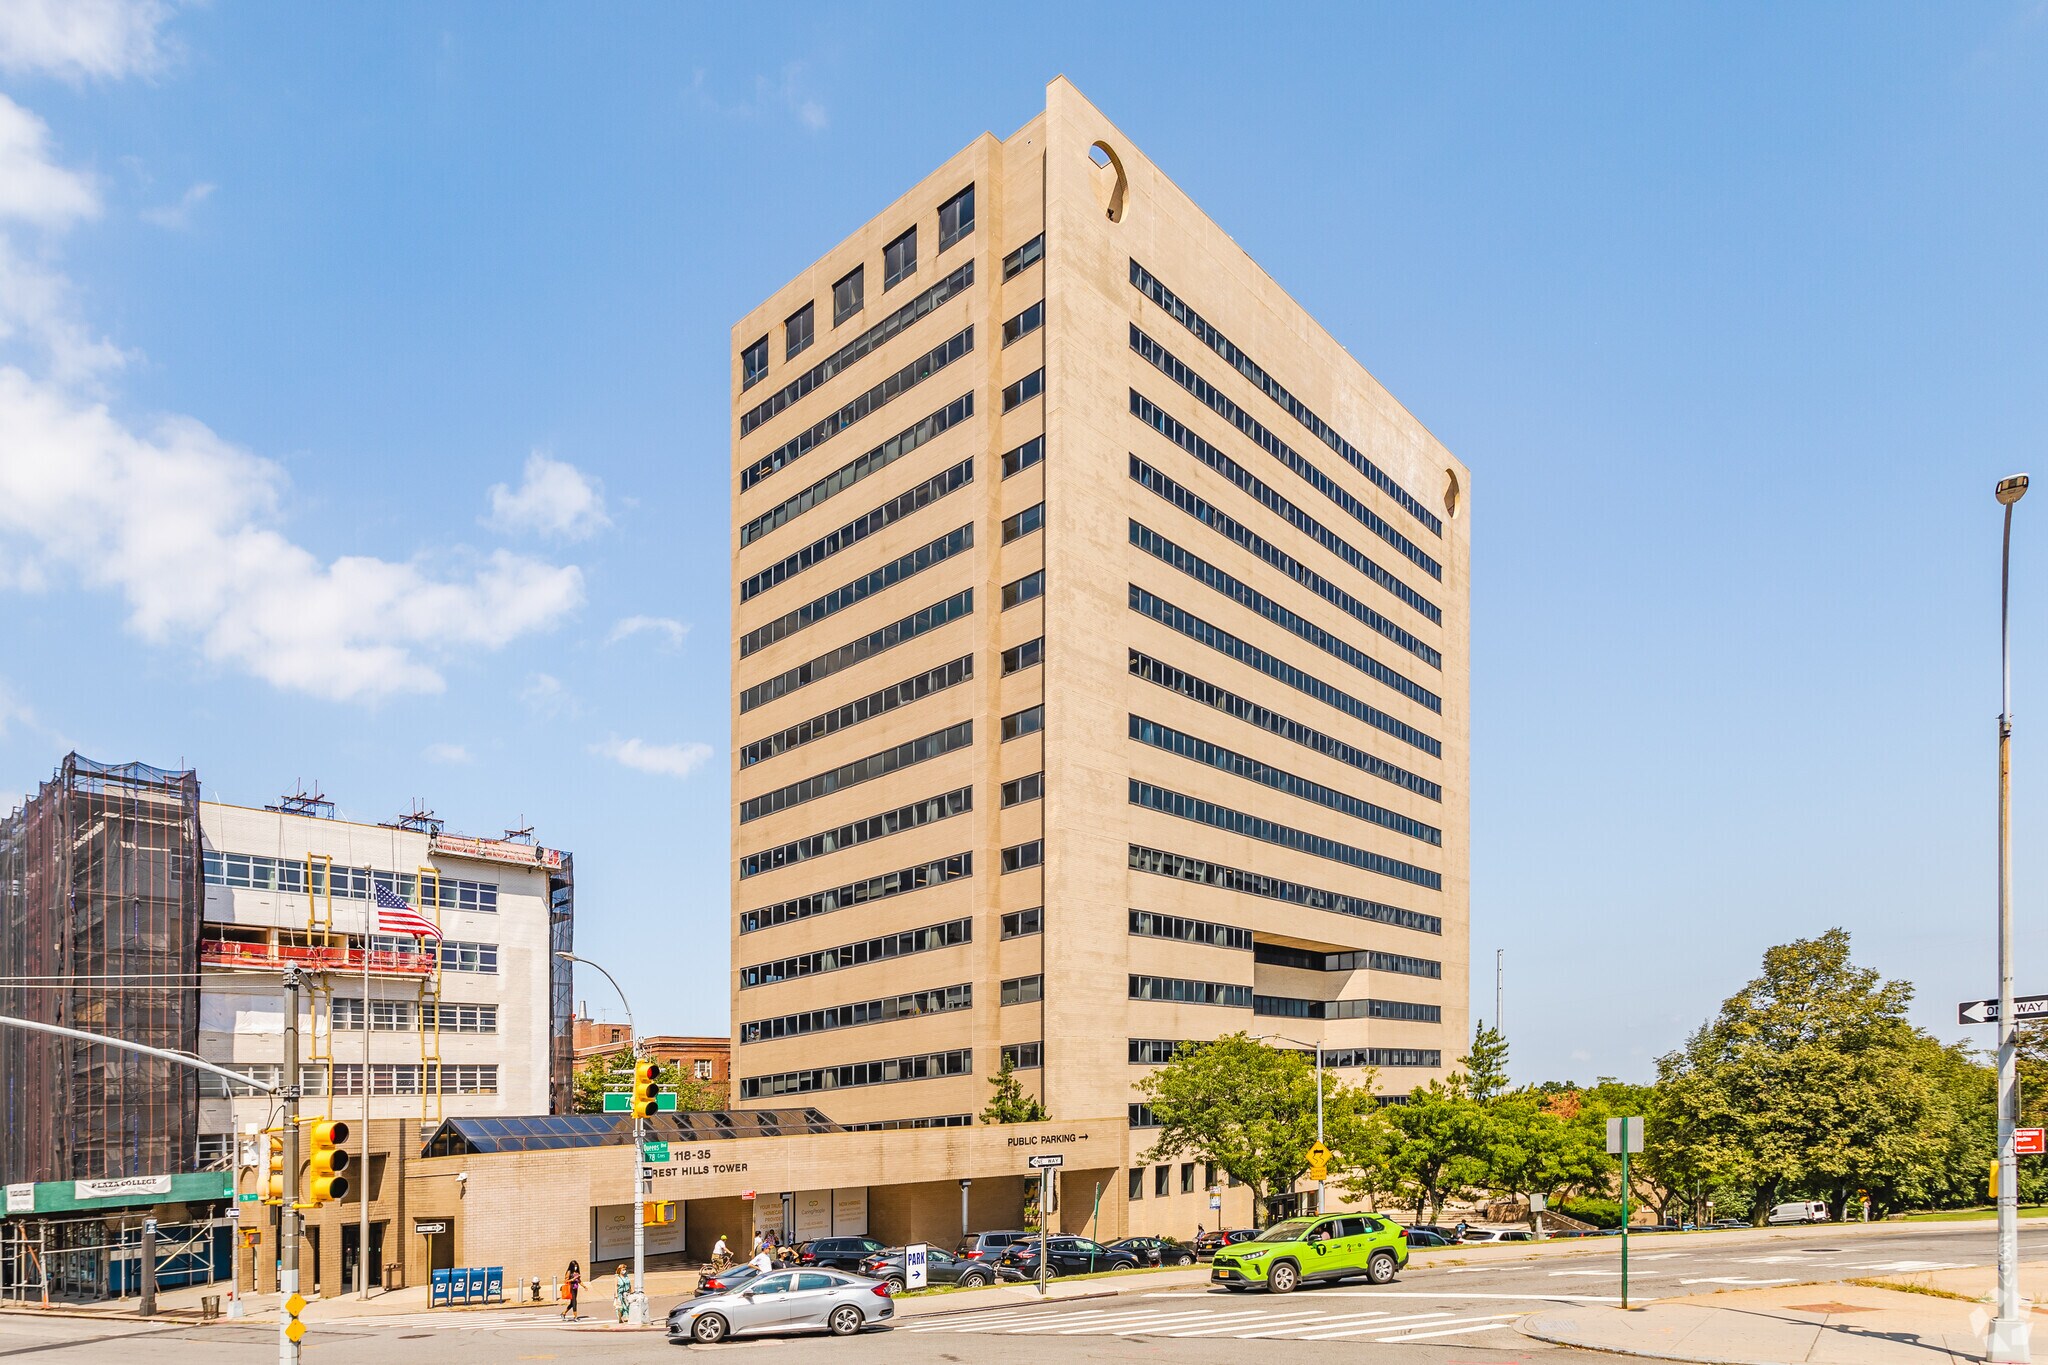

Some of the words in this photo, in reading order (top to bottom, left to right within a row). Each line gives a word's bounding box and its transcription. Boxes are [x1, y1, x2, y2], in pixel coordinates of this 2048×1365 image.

[2016, 1002, 2044, 1012] WAY
[1007, 1136, 1038, 1146] PUBLIC
[1040, 1133, 1076, 1144] PARKING
[643, 1143, 660, 1152] Queens
[648, 1153, 656, 1161] 78
[674, 1149, 711, 1161] 118-35
[652, 1168, 677, 1178] REST
[681, 1166, 709, 1176] HILLS
[713, 1163, 748, 1173] TOWER
[91, 1181, 119, 1189] PLAZA
[121, 1178, 157, 1187] COLLEGE
[908, 1251, 926, 1266] PARK
